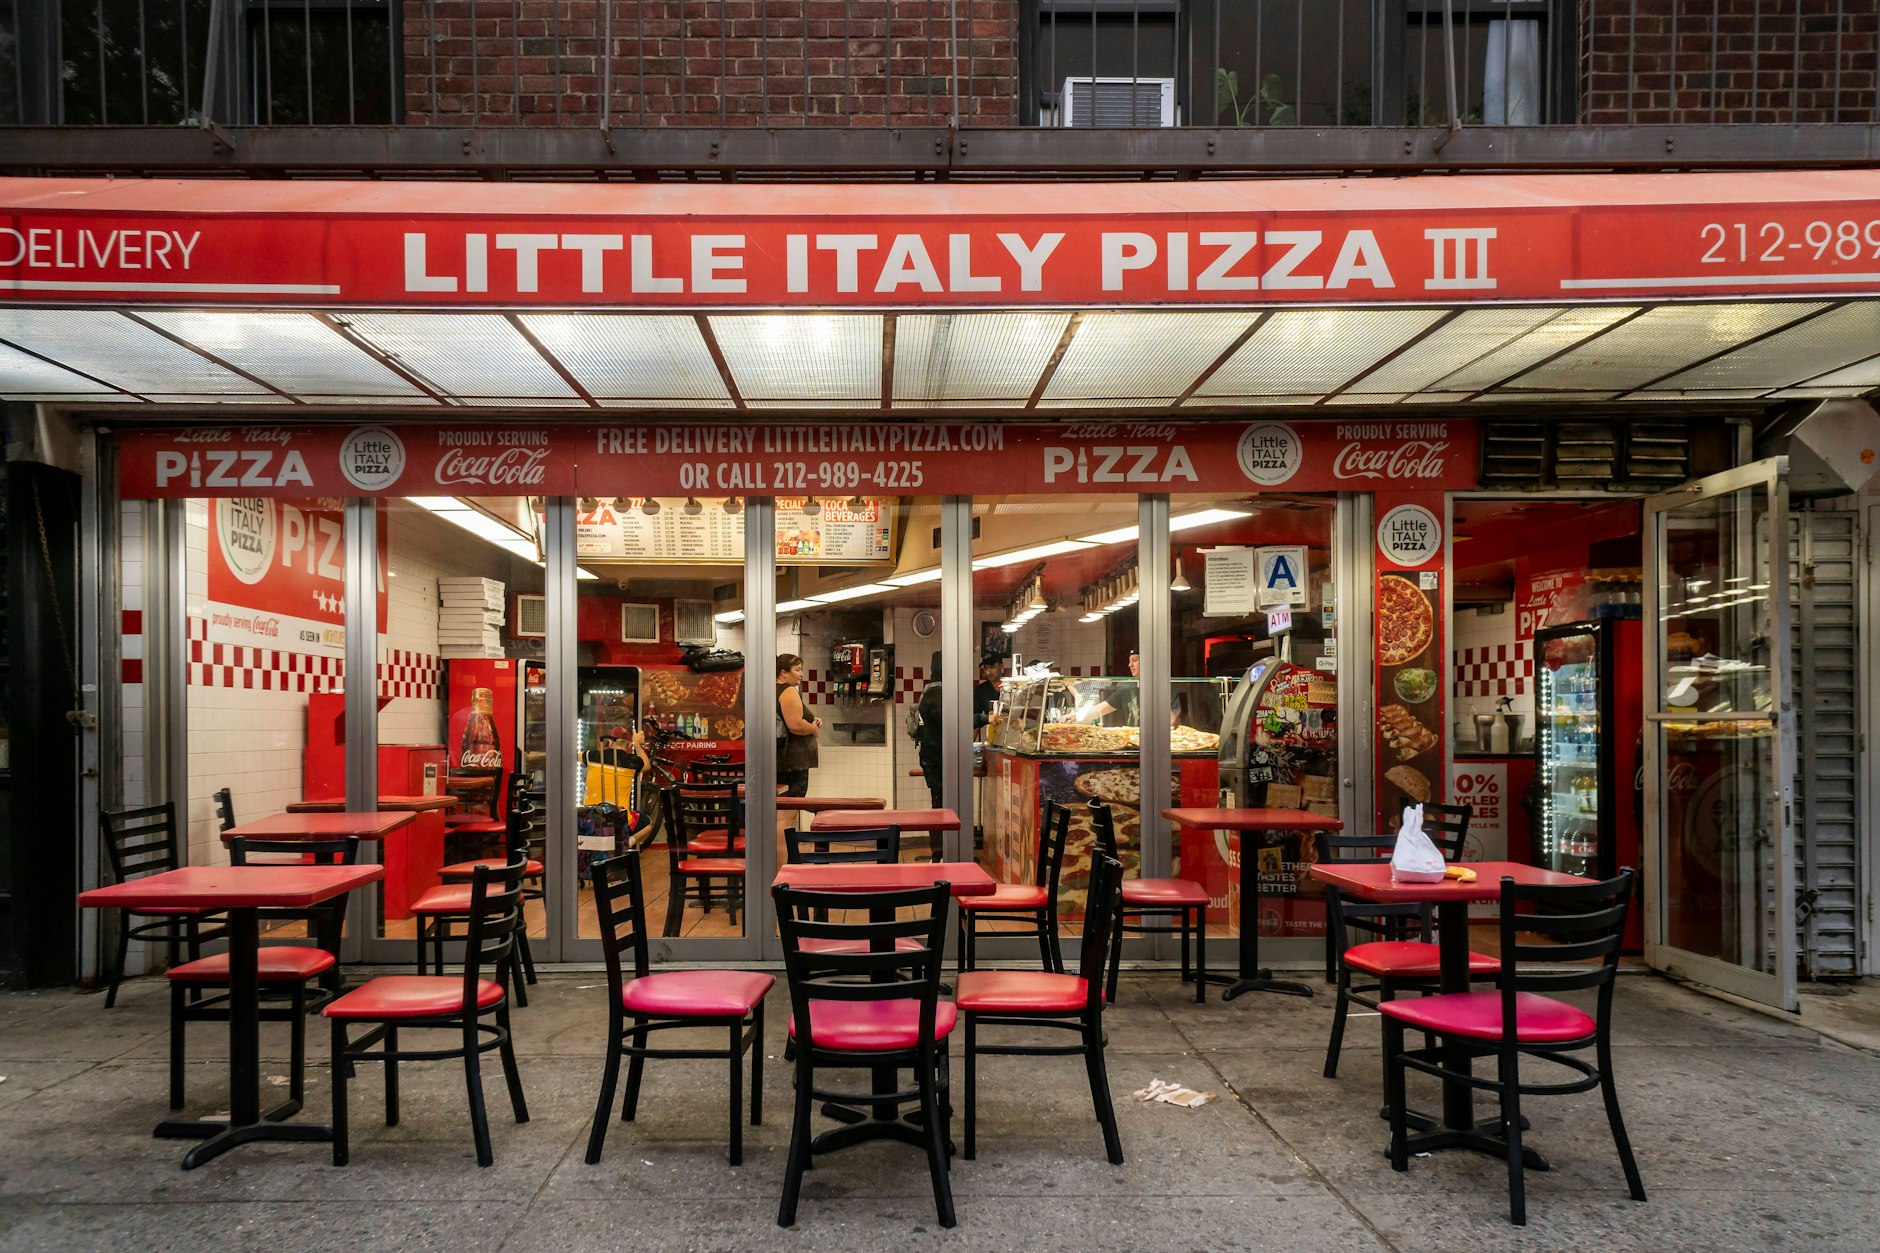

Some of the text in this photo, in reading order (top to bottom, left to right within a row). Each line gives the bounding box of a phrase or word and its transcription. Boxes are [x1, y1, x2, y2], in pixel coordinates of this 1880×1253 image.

[0, 228, 200, 270] DELIVERY
[404, 227, 1498, 294] LITTLE ITALY PIZZA III
[174, 426, 293, 447] Little Italy
[438, 430, 549, 446] PROUDLY SERVING
[596, 424, 1004, 454] FREE DELIVERY LITTLEITALYPIZZA.COM
[1060, 424, 1177, 442] Little Italy
[1336, 423, 1448, 440] PROUDLY SERVING
[354, 441, 391, 453] Little
[1252, 436, 1288, 448] Little
[354, 454, 391, 464] ITALY
[1252, 449, 1288, 459] ITALY
[1333, 441, 1450, 480] Coca-Cola
[156, 450, 315, 488] PIZZA
[354, 466, 390, 474] PIZZA
[434, 448, 552, 485] Coca-Cola
[1044, 446, 1200, 484] PIZZA
[1252, 460, 1288, 469] PIZZA
[679, 460, 924, 490] OR CALL 212-989-4225
[231, 508, 264, 535] ITALY
[825, 512, 876, 522] BEVERAGES
[1392, 520, 1427, 531] Little
[231, 531, 264, 555] PIZZA
[1392, 532, 1428, 542] ITALY
[1267, 556, 1297, 588] A
[1531, 577, 1562, 592] WELCOME TO
[1271, 612, 1290, 628] ATM
[460, 749, 502, 768] Coca-Cola
[1454, 774, 1499, 794] 0%
[1454, 796, 1500, 806] YCLED
